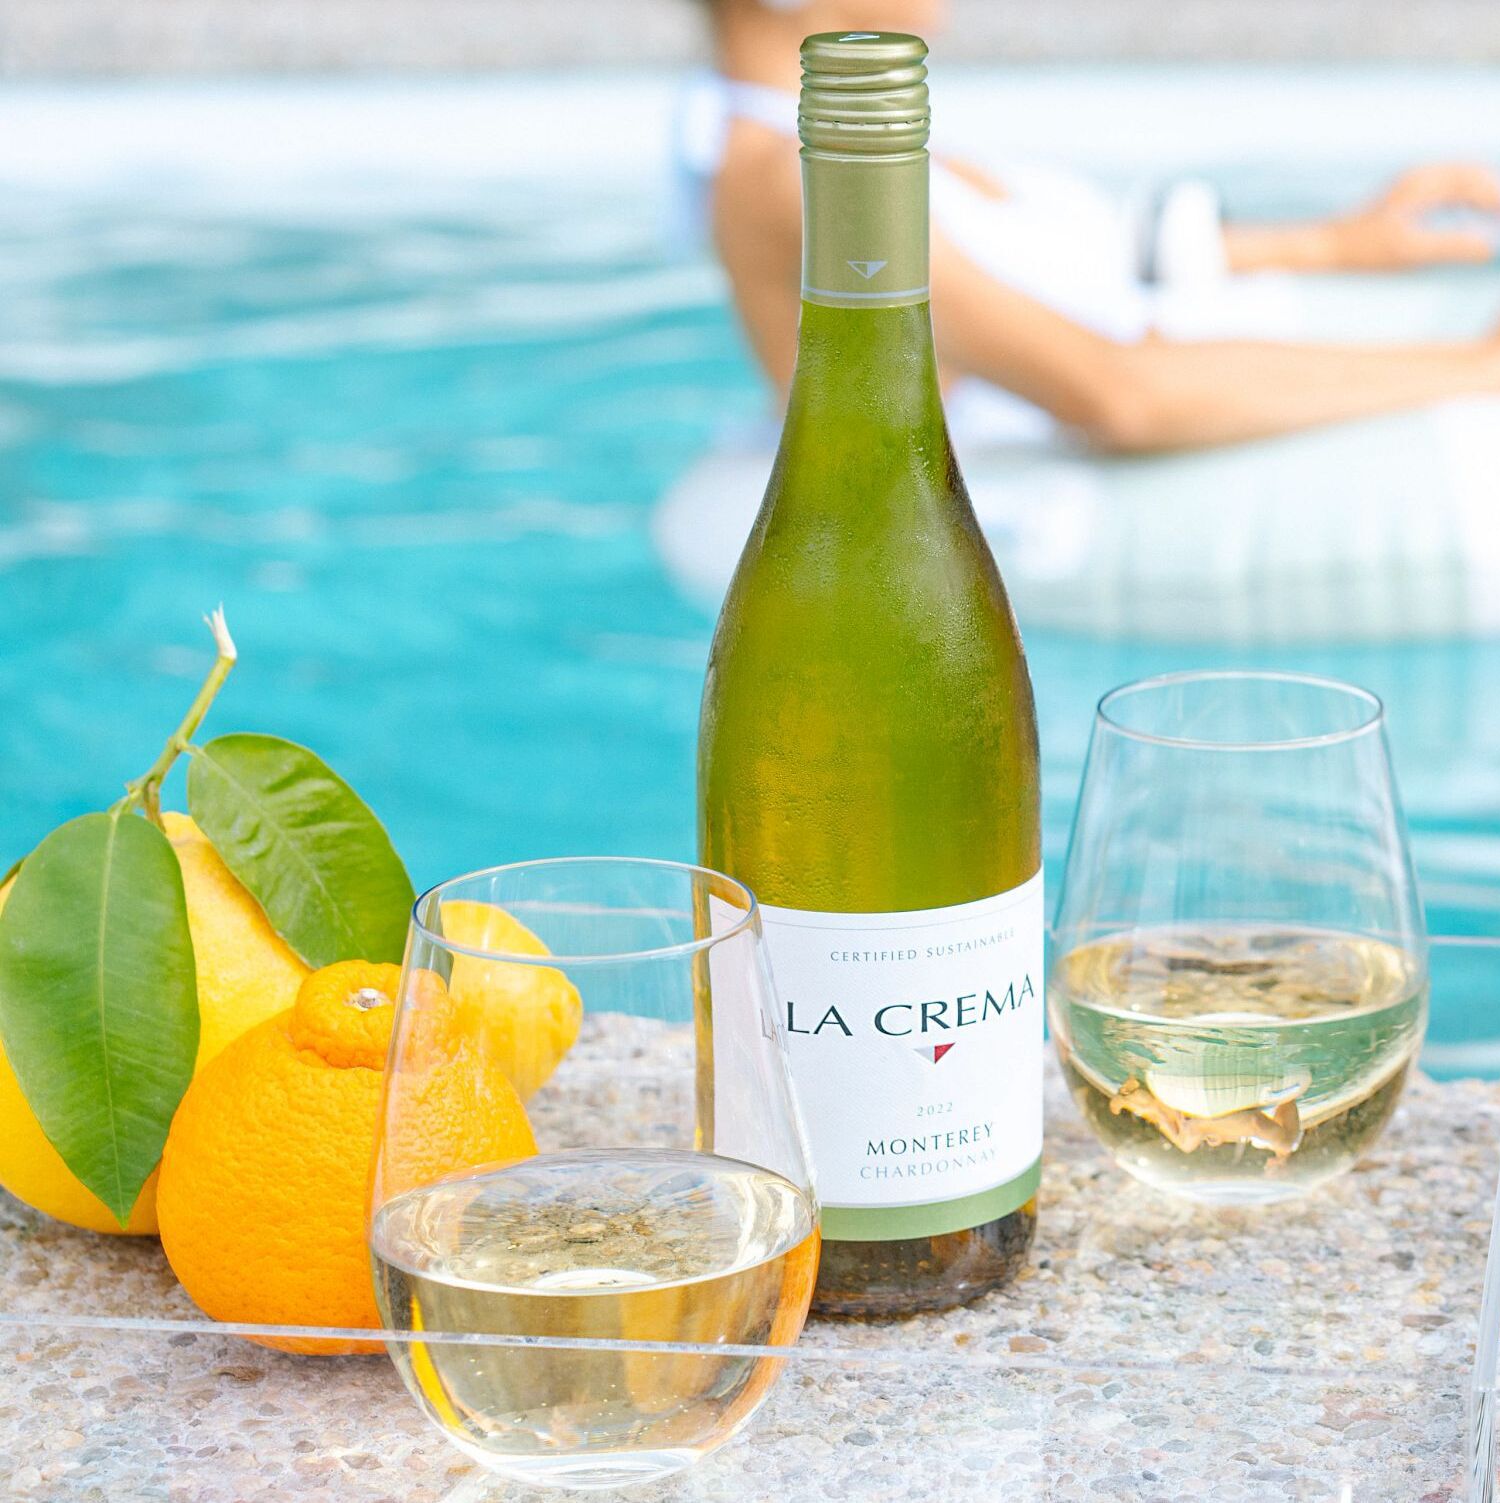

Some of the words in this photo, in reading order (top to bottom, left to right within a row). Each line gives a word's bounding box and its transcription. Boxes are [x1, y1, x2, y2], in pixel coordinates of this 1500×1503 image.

[830, 949, 917, 962] CERTIFIED
[926, 927, 1015, 958] SUSTAINABLE
[787, 1001, 853, 1036] LA
[874, 973, 1034, 1036] CREMA
[916, 1102, 953, 1117] 2022
[866, 1121, 994, 1156] MONTEREY
[860, 1148, 998, 1179] CHARDONNAY
